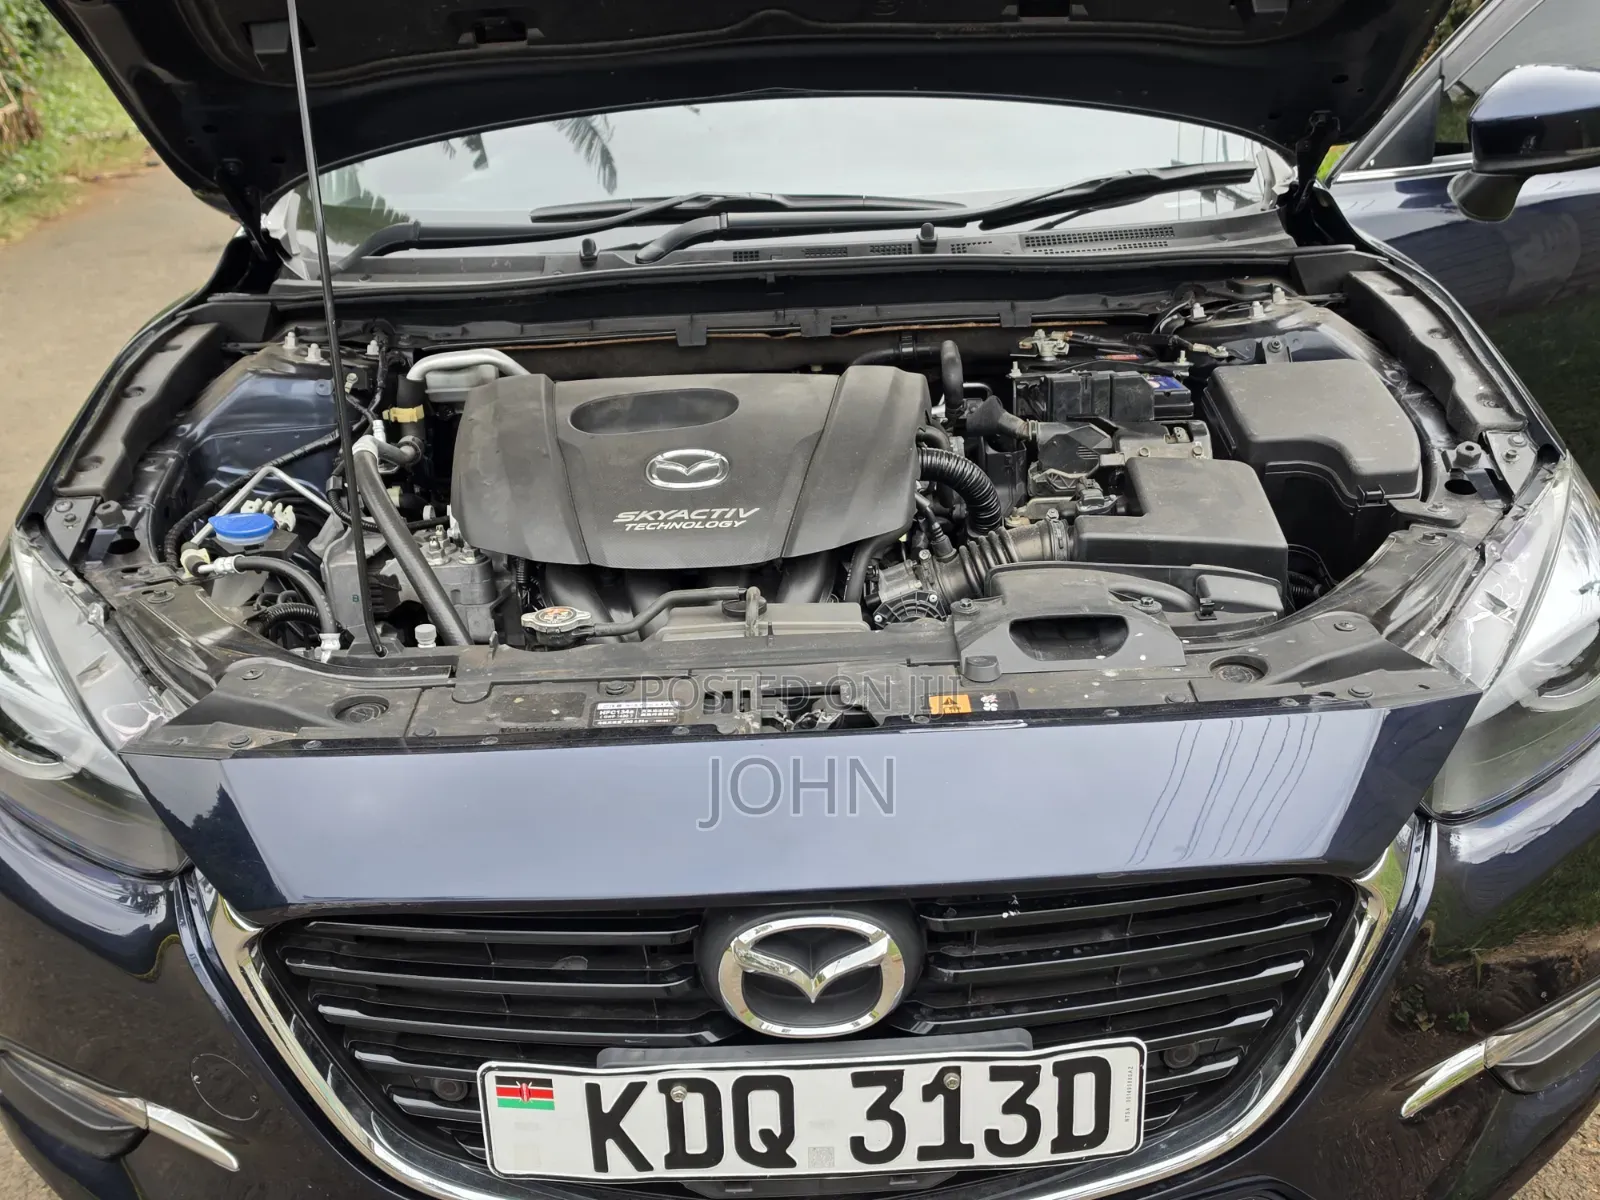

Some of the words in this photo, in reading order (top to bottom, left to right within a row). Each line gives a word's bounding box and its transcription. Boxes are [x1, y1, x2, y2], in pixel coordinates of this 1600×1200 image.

[612, 507, 760, 523] SKYACTIV
[625, 519, 747, 531] TECHNOLOGY
[585, 1074, 797, 1173] KDQ
[849, 1056, 1111, 1164] 313D
